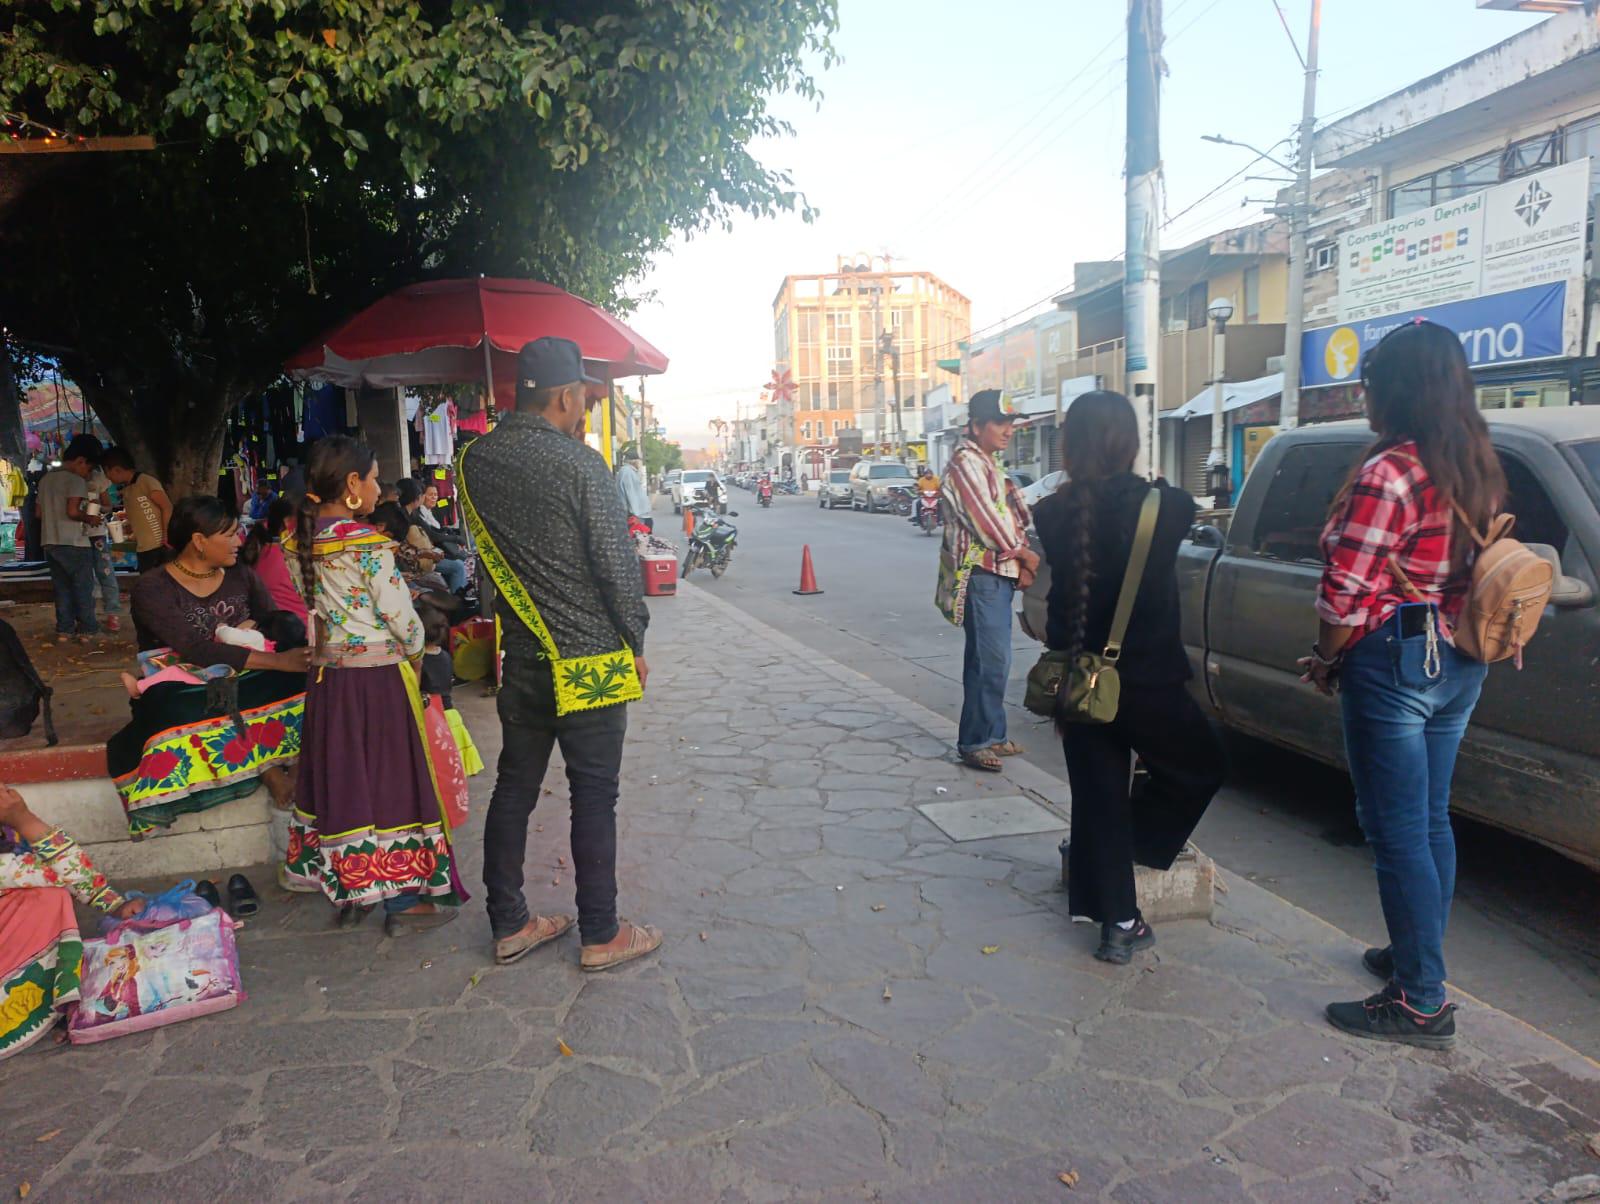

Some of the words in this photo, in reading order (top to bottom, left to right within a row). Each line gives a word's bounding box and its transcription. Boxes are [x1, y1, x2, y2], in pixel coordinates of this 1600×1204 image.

[1347, 216, 1426, 247] Consultorio
[1434, 196, 1481, 222] Dental
[1364, 323, 1402, 342] farm
[1459, 322, 1524, 362] rna
